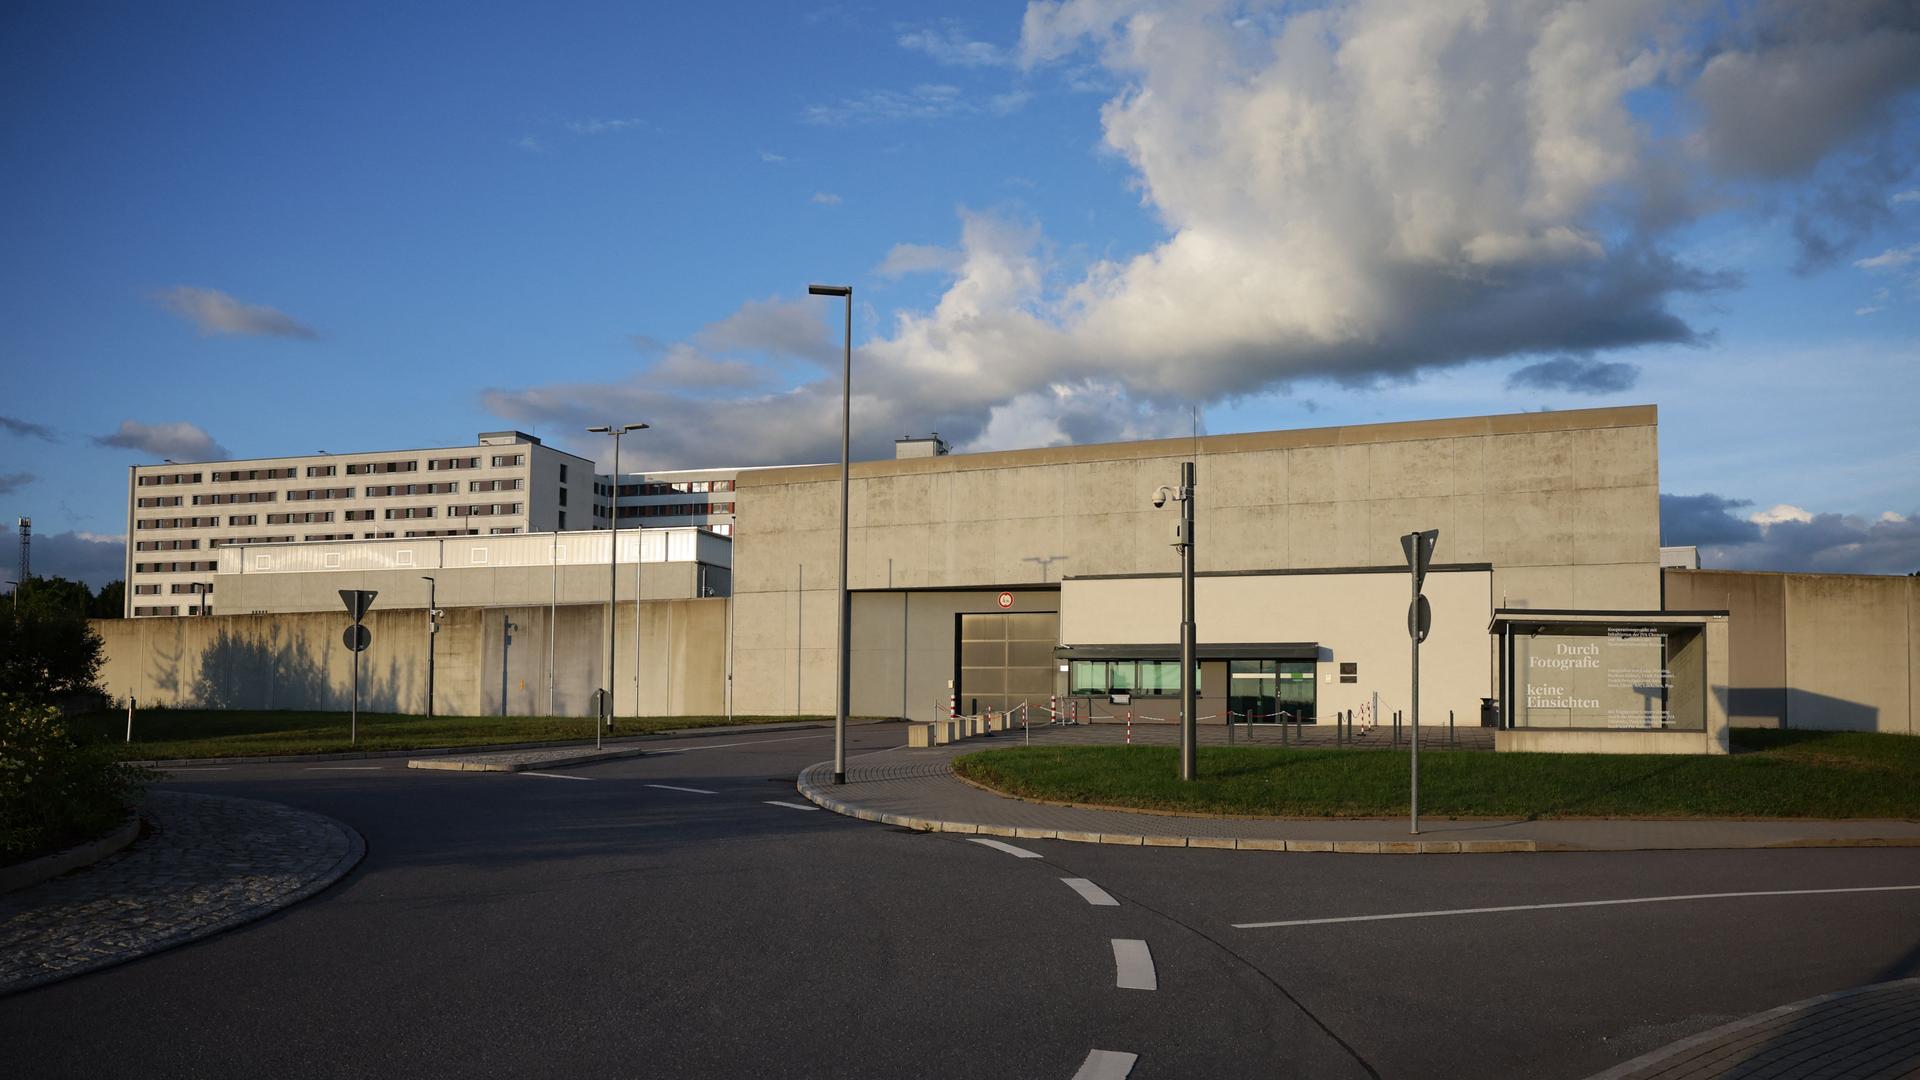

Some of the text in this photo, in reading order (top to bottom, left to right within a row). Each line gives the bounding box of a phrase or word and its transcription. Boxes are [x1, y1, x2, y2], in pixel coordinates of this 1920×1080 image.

[1557, 643, 1599, 655] Durch
[1529, 656, 1600, 671] Fotografie
[1527, 683, 1564, 695] keine
[1527, 696, 1600, 708] Einsichten
